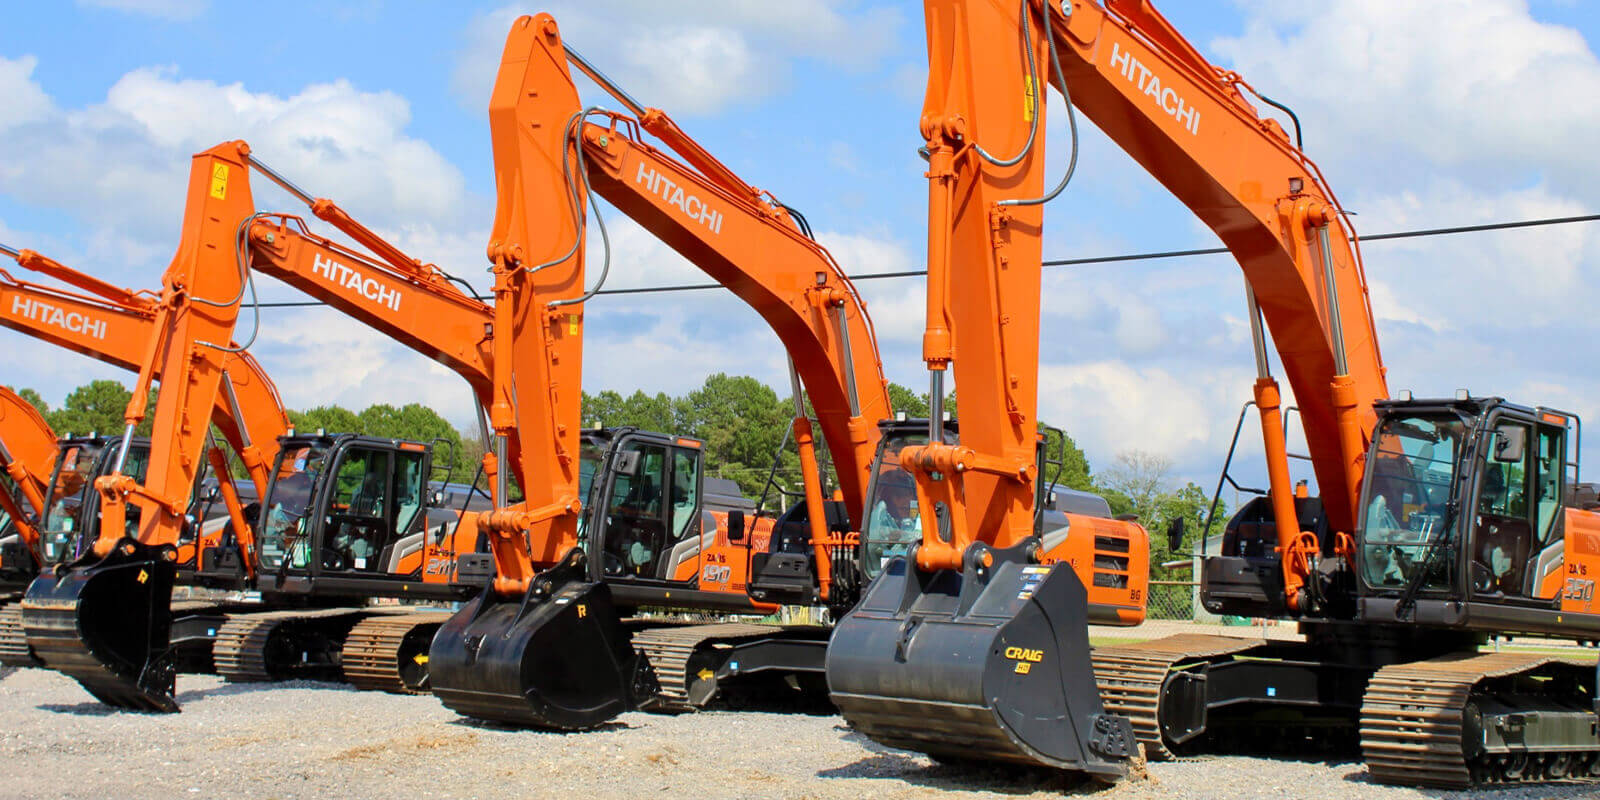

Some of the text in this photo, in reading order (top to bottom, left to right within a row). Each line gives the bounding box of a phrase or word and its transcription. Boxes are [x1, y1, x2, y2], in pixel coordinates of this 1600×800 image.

[1110, 43, 1201, 136] HITACHI
[636, 162, 723, 235] HITACHI
[312, 252, 402, 312] HITACHI
[12, 295, 107, 340] HITACHI
[1564, 577, 1595, 602] 350
[1005, 646, 1044, 663] CRAIG
